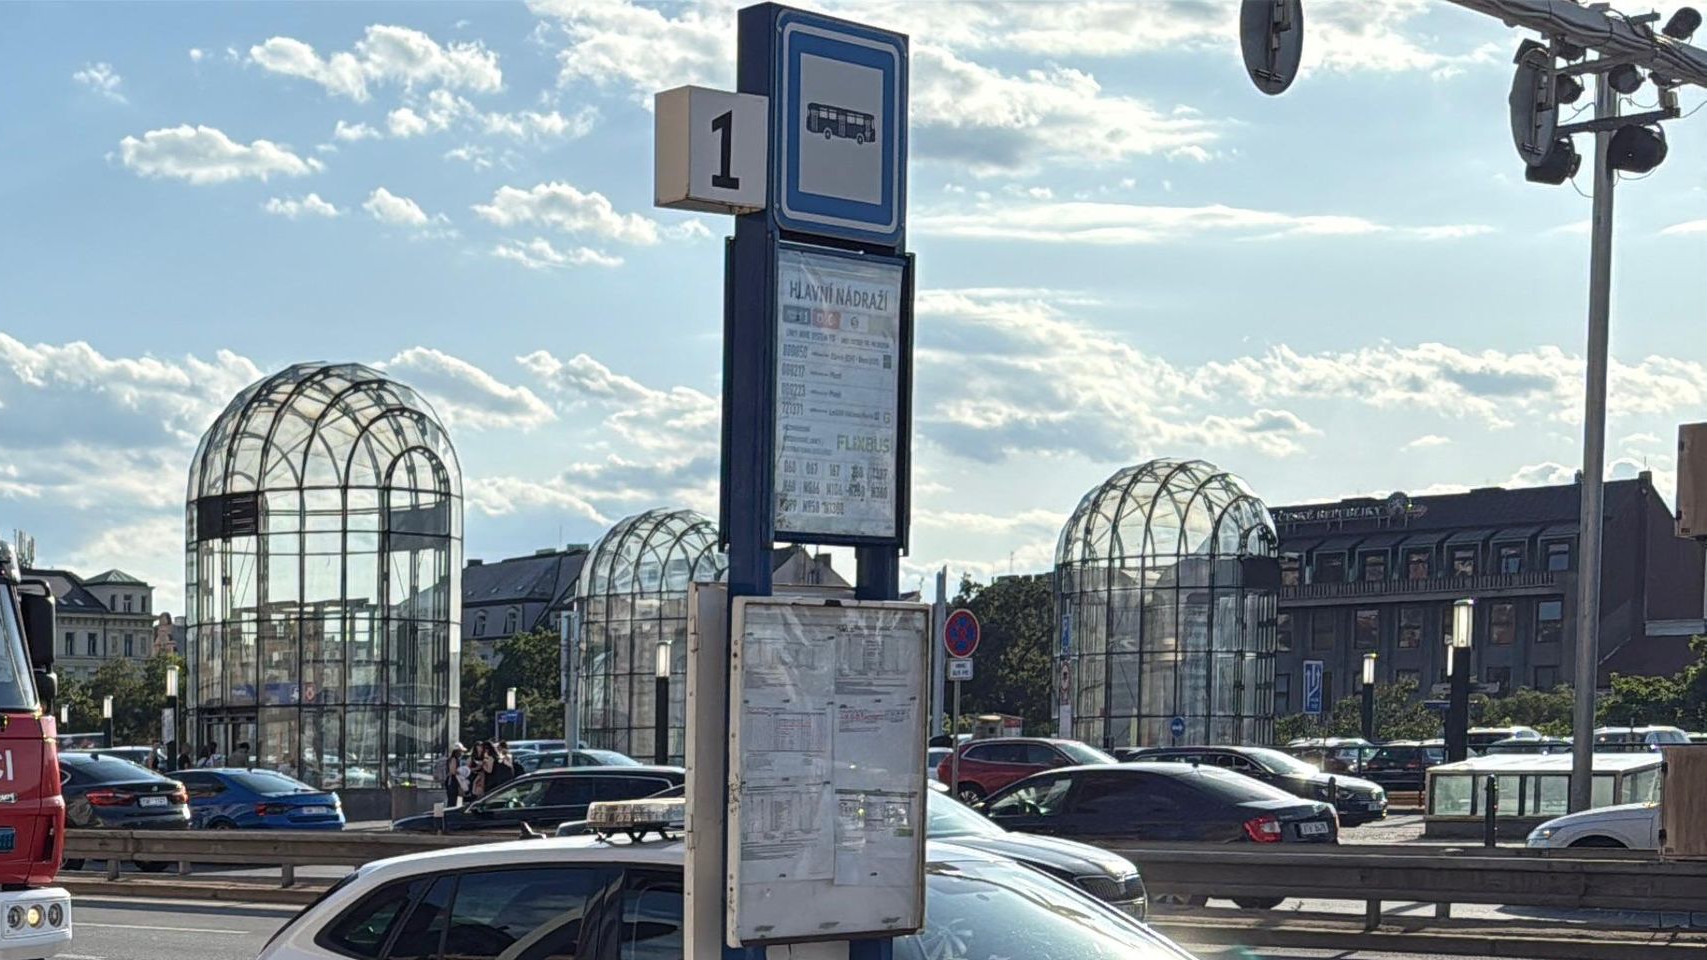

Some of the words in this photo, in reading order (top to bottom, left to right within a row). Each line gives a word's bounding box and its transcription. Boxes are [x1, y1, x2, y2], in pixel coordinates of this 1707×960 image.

[712, 110, 739, 190] 1
[790, 281, 833, 304] HLAVNÍ
[836, 286, 888, 311] NÁDRAŽÍ
